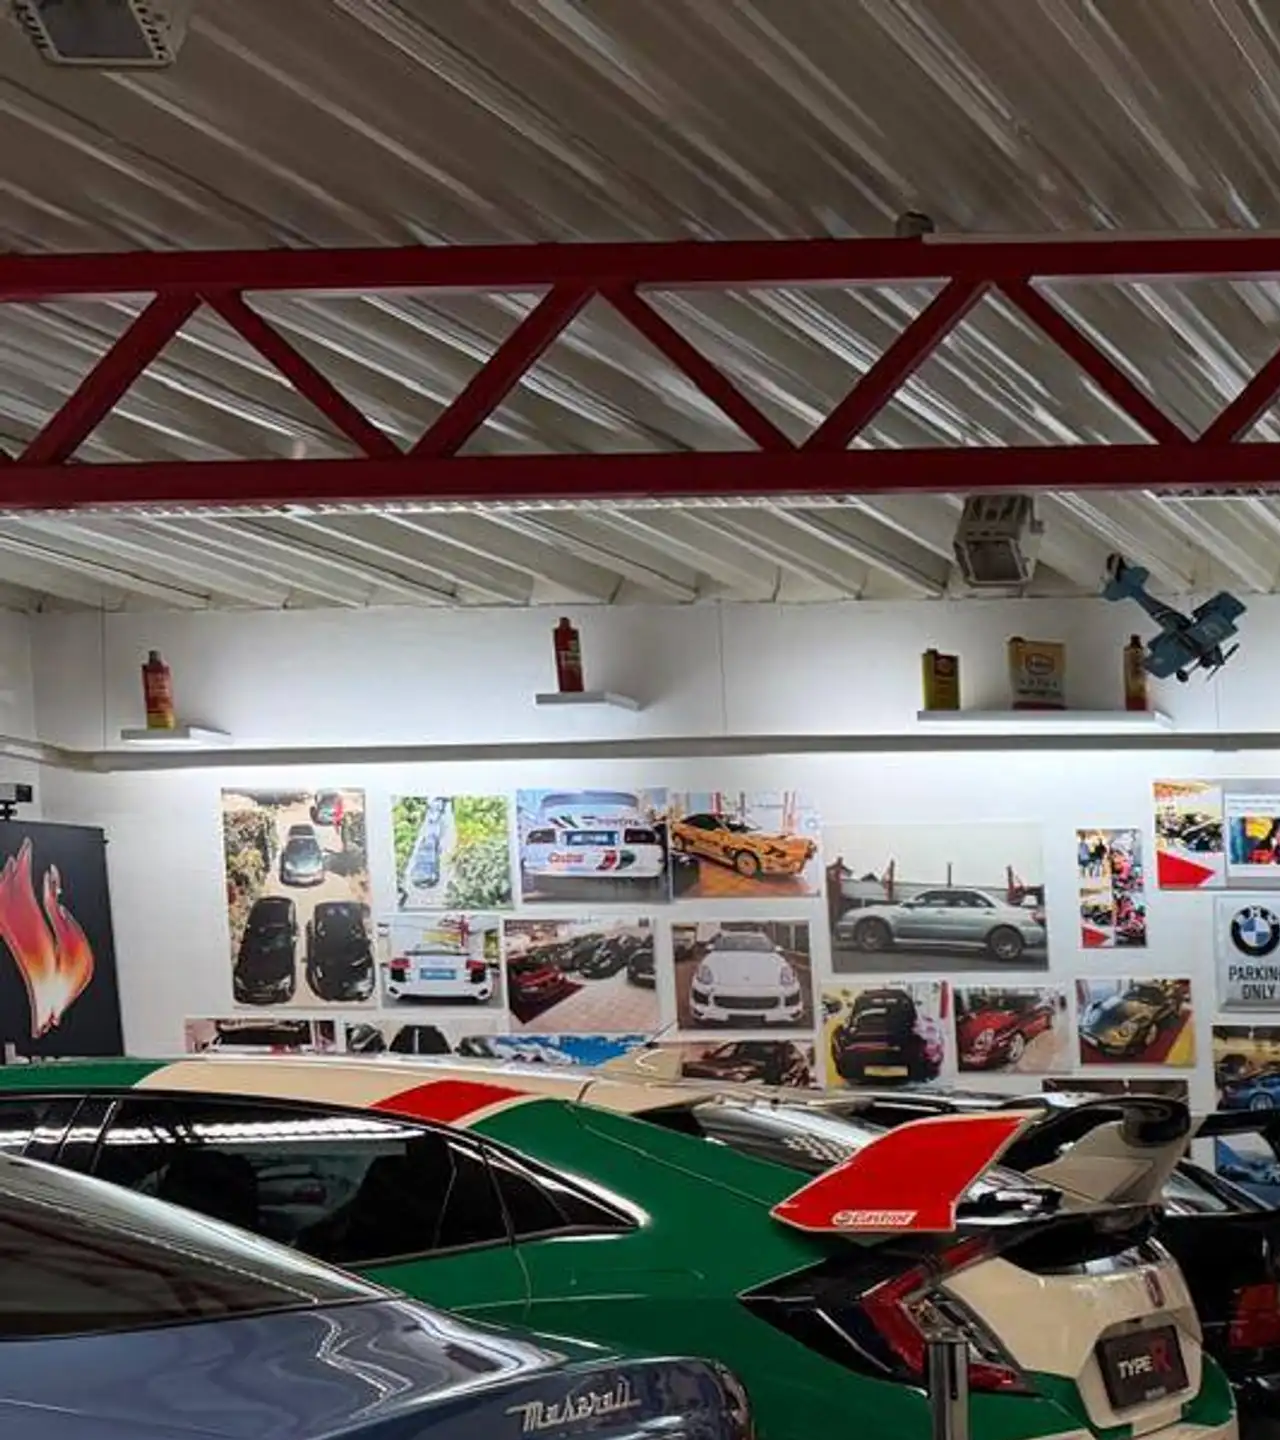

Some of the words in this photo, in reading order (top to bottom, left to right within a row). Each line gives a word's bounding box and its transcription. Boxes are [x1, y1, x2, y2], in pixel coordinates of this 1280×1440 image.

[1241, 983, 1276, 1000] ONLY
[1117, 1354, 1154, 1380] TYPE
[506, 1376, 642, 1433] Maserati
